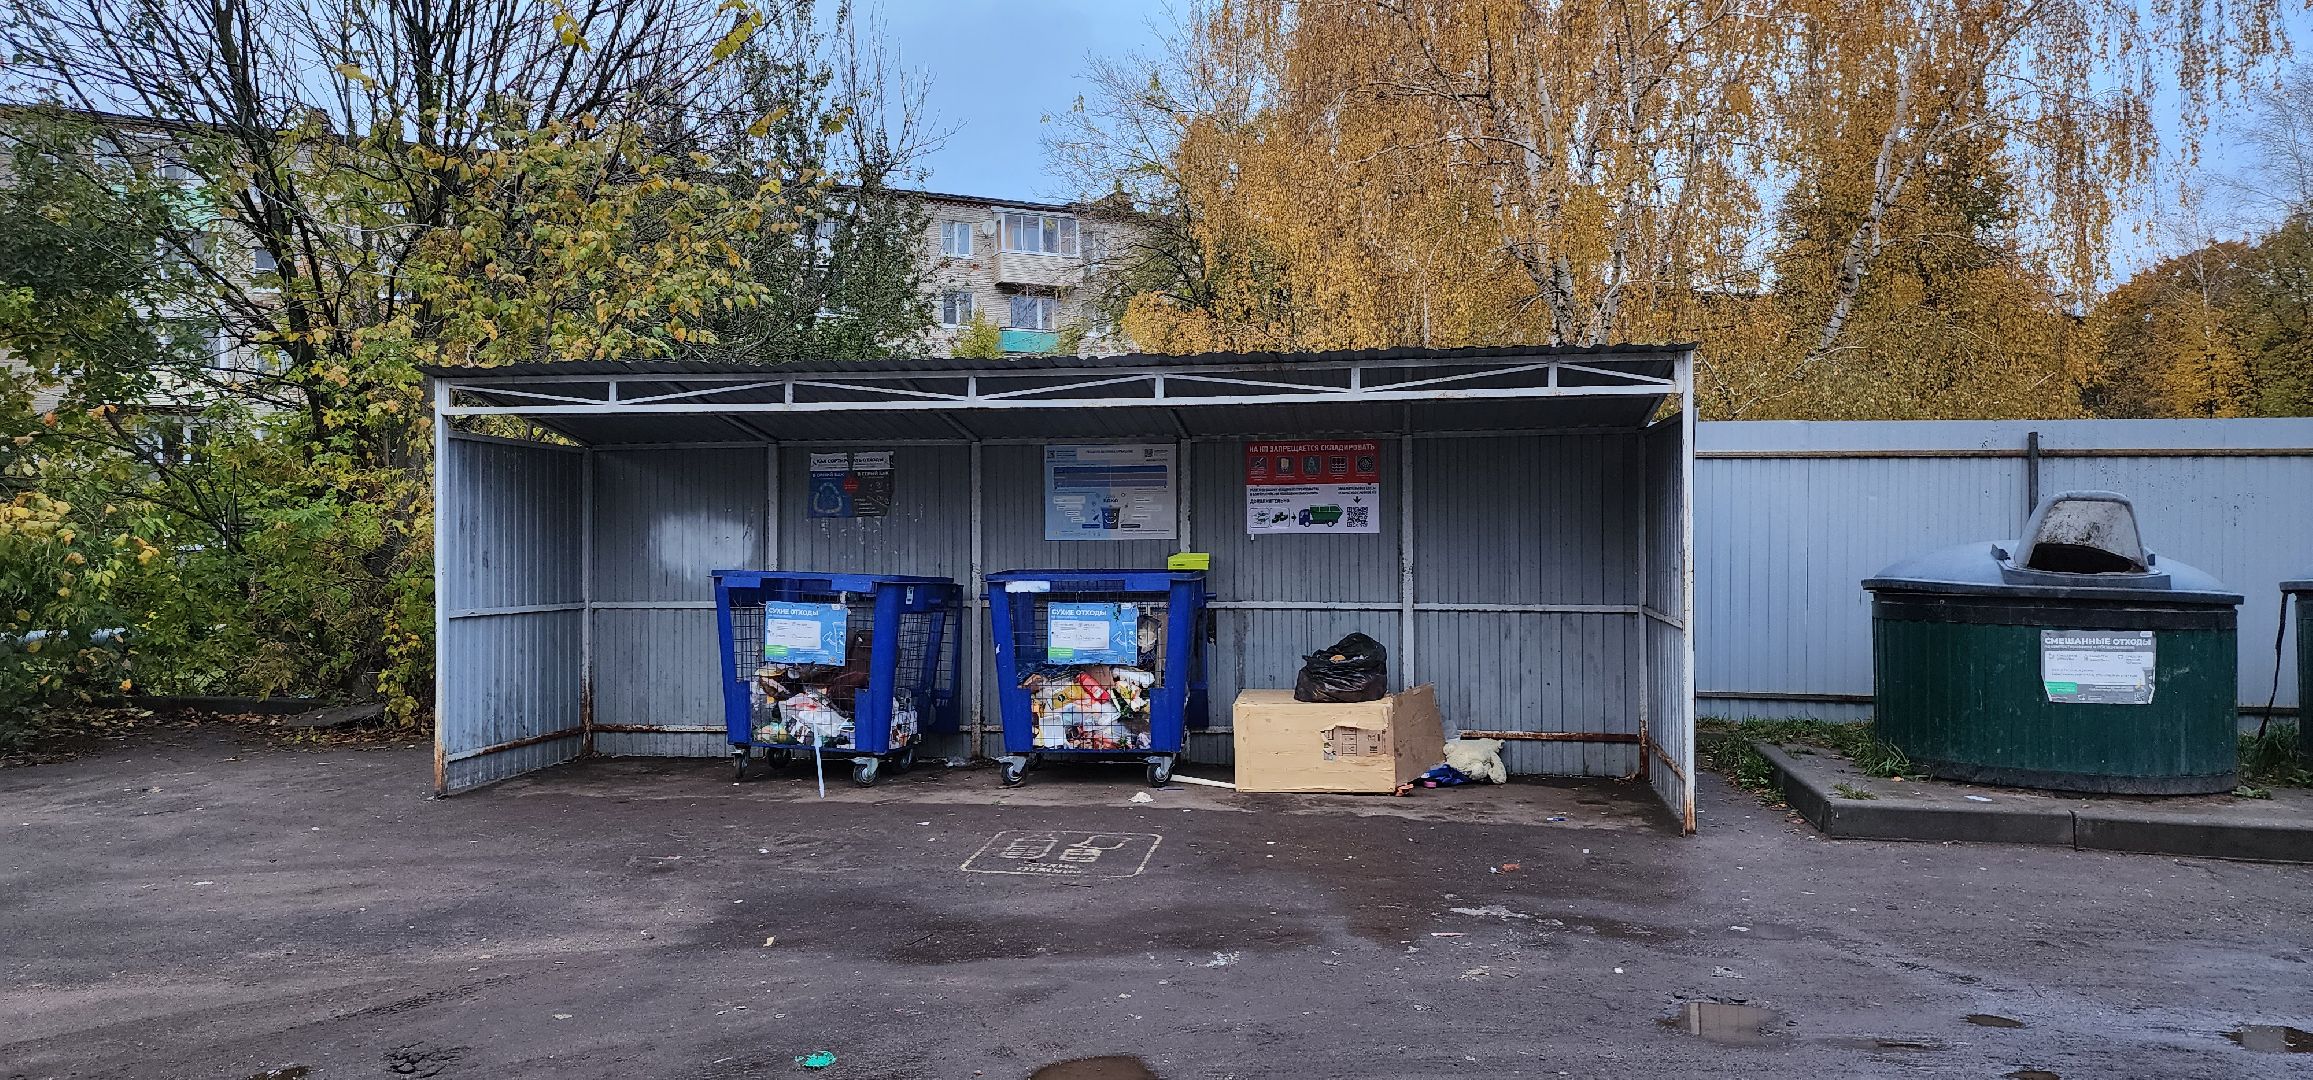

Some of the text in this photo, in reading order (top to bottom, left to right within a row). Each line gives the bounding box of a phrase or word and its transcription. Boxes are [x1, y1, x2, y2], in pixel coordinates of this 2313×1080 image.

[1270, 444, 1318, 452] ЗАПРЕЩАЕТСЯ
[1320, 443, 1375, 452] СКЛАДИРОВАТЬ
[768, 607, 819, 617] СУХИЕ ОТХОДЫ
[1075, 609, 1107, 617] ОТХОДЫ
[2044, 637, 2152, 646] СМЕШАННЫЕ ОТХОДЫ
